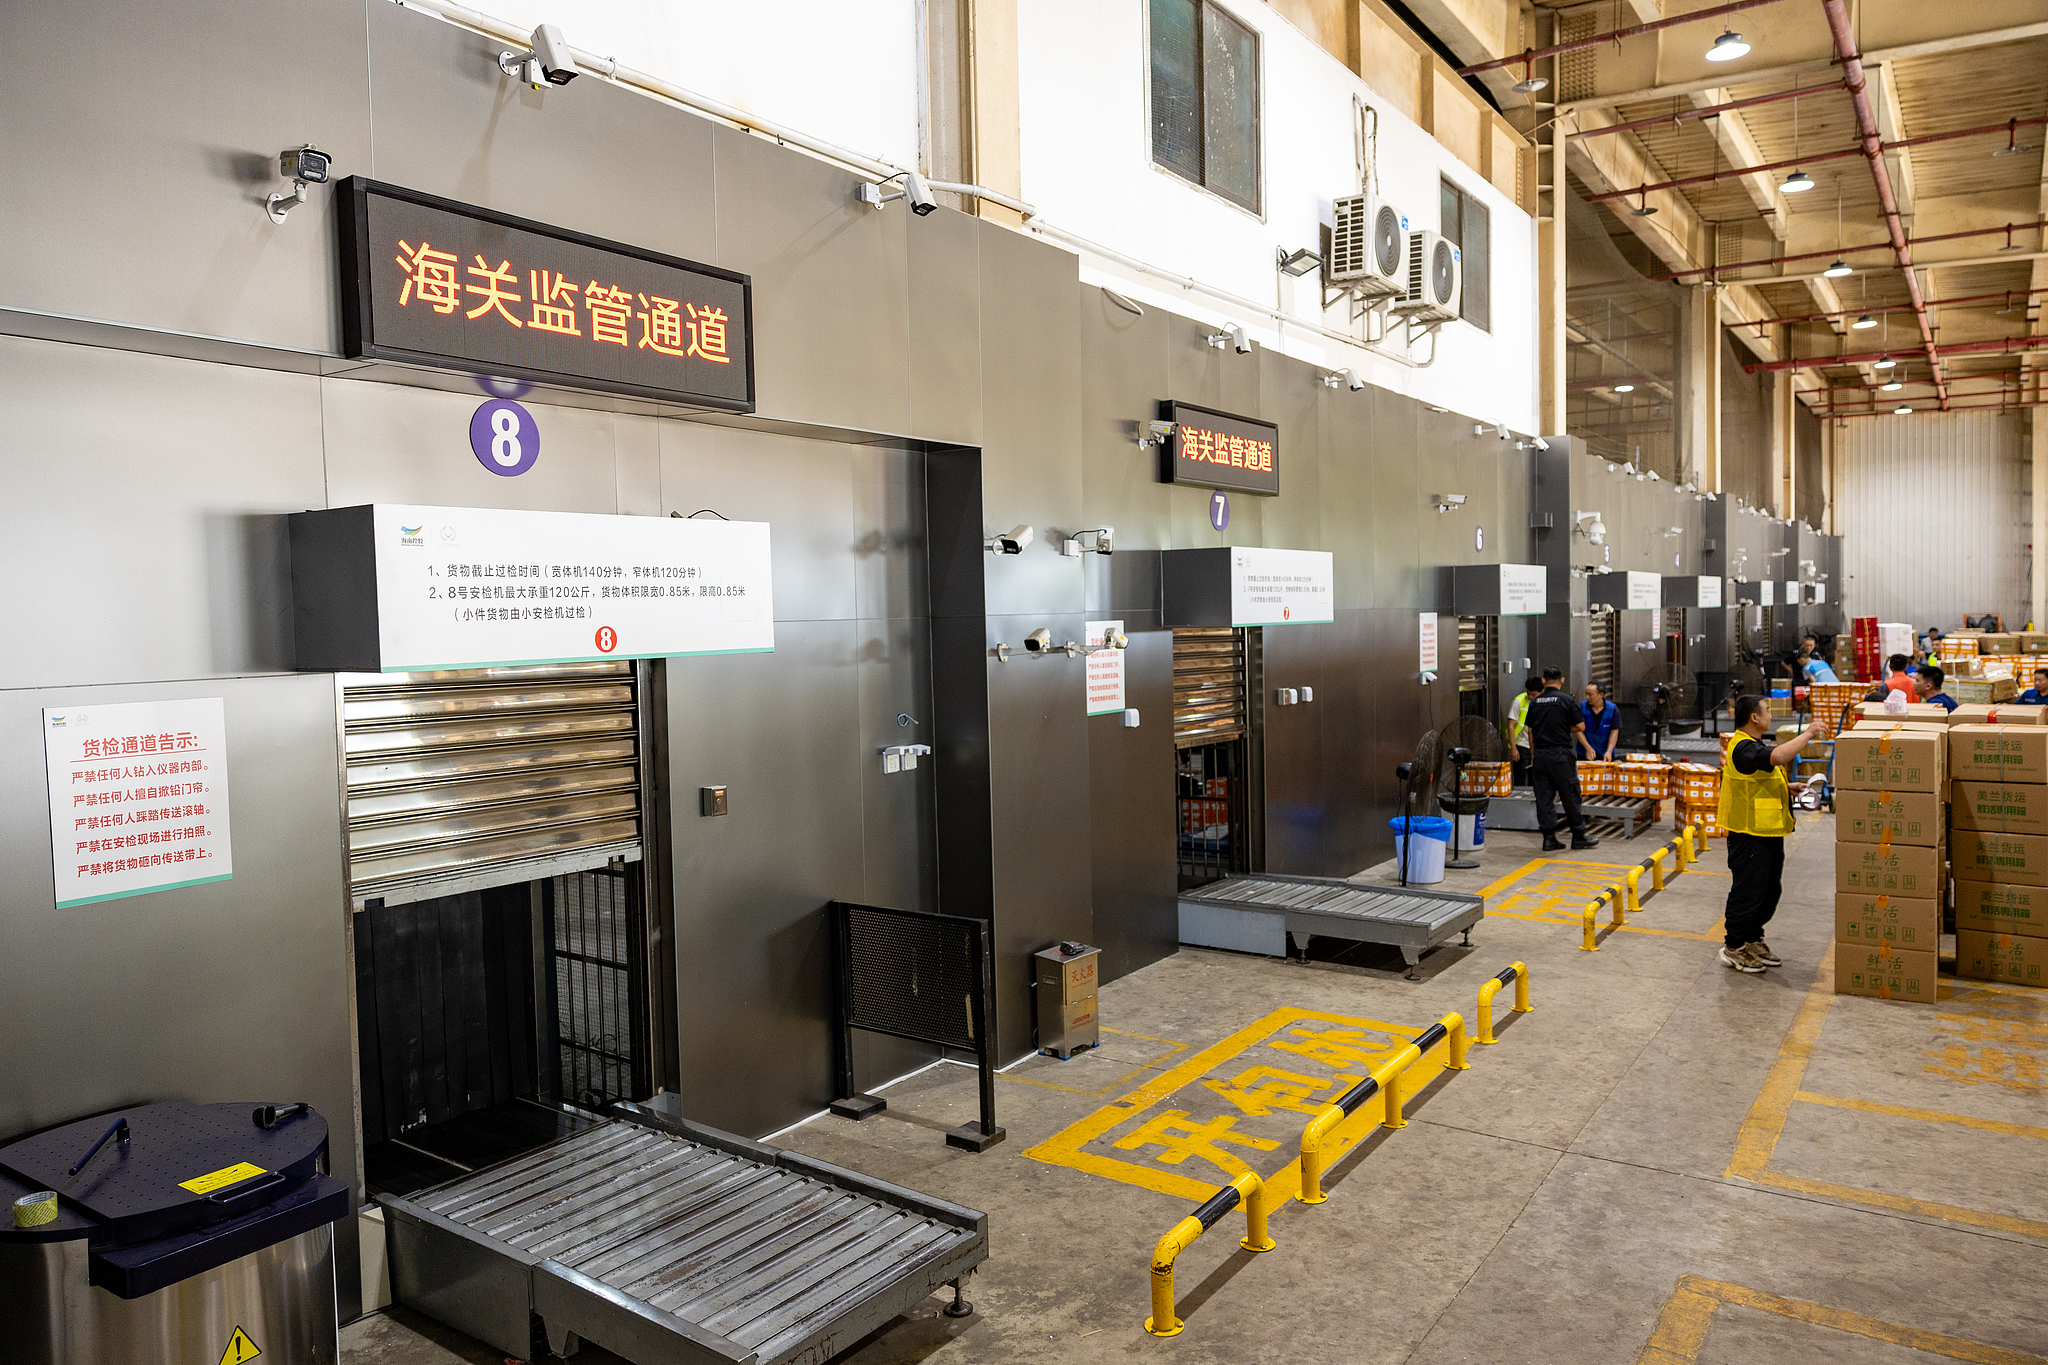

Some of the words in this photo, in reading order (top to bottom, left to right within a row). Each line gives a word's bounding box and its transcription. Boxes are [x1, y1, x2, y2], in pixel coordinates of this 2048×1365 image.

[395, 238, 731, 365] 海关监管通道
[490, 408, 522, 467] 8
[1181, 426, 1273, 473] 海关监管通道
[1215, 495, 1225, 526] 7
[454, 605, 592, 622] （小件货物由小安检机过检）
[600, 627, 612, 651] 8
[82, 731, 198, 759] 货检通道告示:
[1867, 745, 1904, 760] 鲜活
[1973, 739, 2023, 751] 美兰货运
[71, 759, 209, 784] 严禁任何人钻入仪器内部。
[73, 781, 210, 808] 严禁任何人擅自掀铅门帘。
[1868, 799, 1904, 814] 鲜活
[1977, 790, 2026, 803] 美兰货运
[75, 803, 211, 831] 严禁任何人踩踏传送滚轴。
[76, 825, 212, 854] 严禁在安检现场进行拍照。
[77, 847, 213, 878] 严禁将货物砸向传送带上。
[1863, 851, 1899, 866] 鲜活
[1862, 902, 1899, 917] 鲜活
[1987, 939, 2024, 955] 鲜活
[1867, 953, 1904, 969] 鲜活
[1072, 964, 1094, 983] 灭火器
[1112, 1028, 1413, 1180] 开包处
